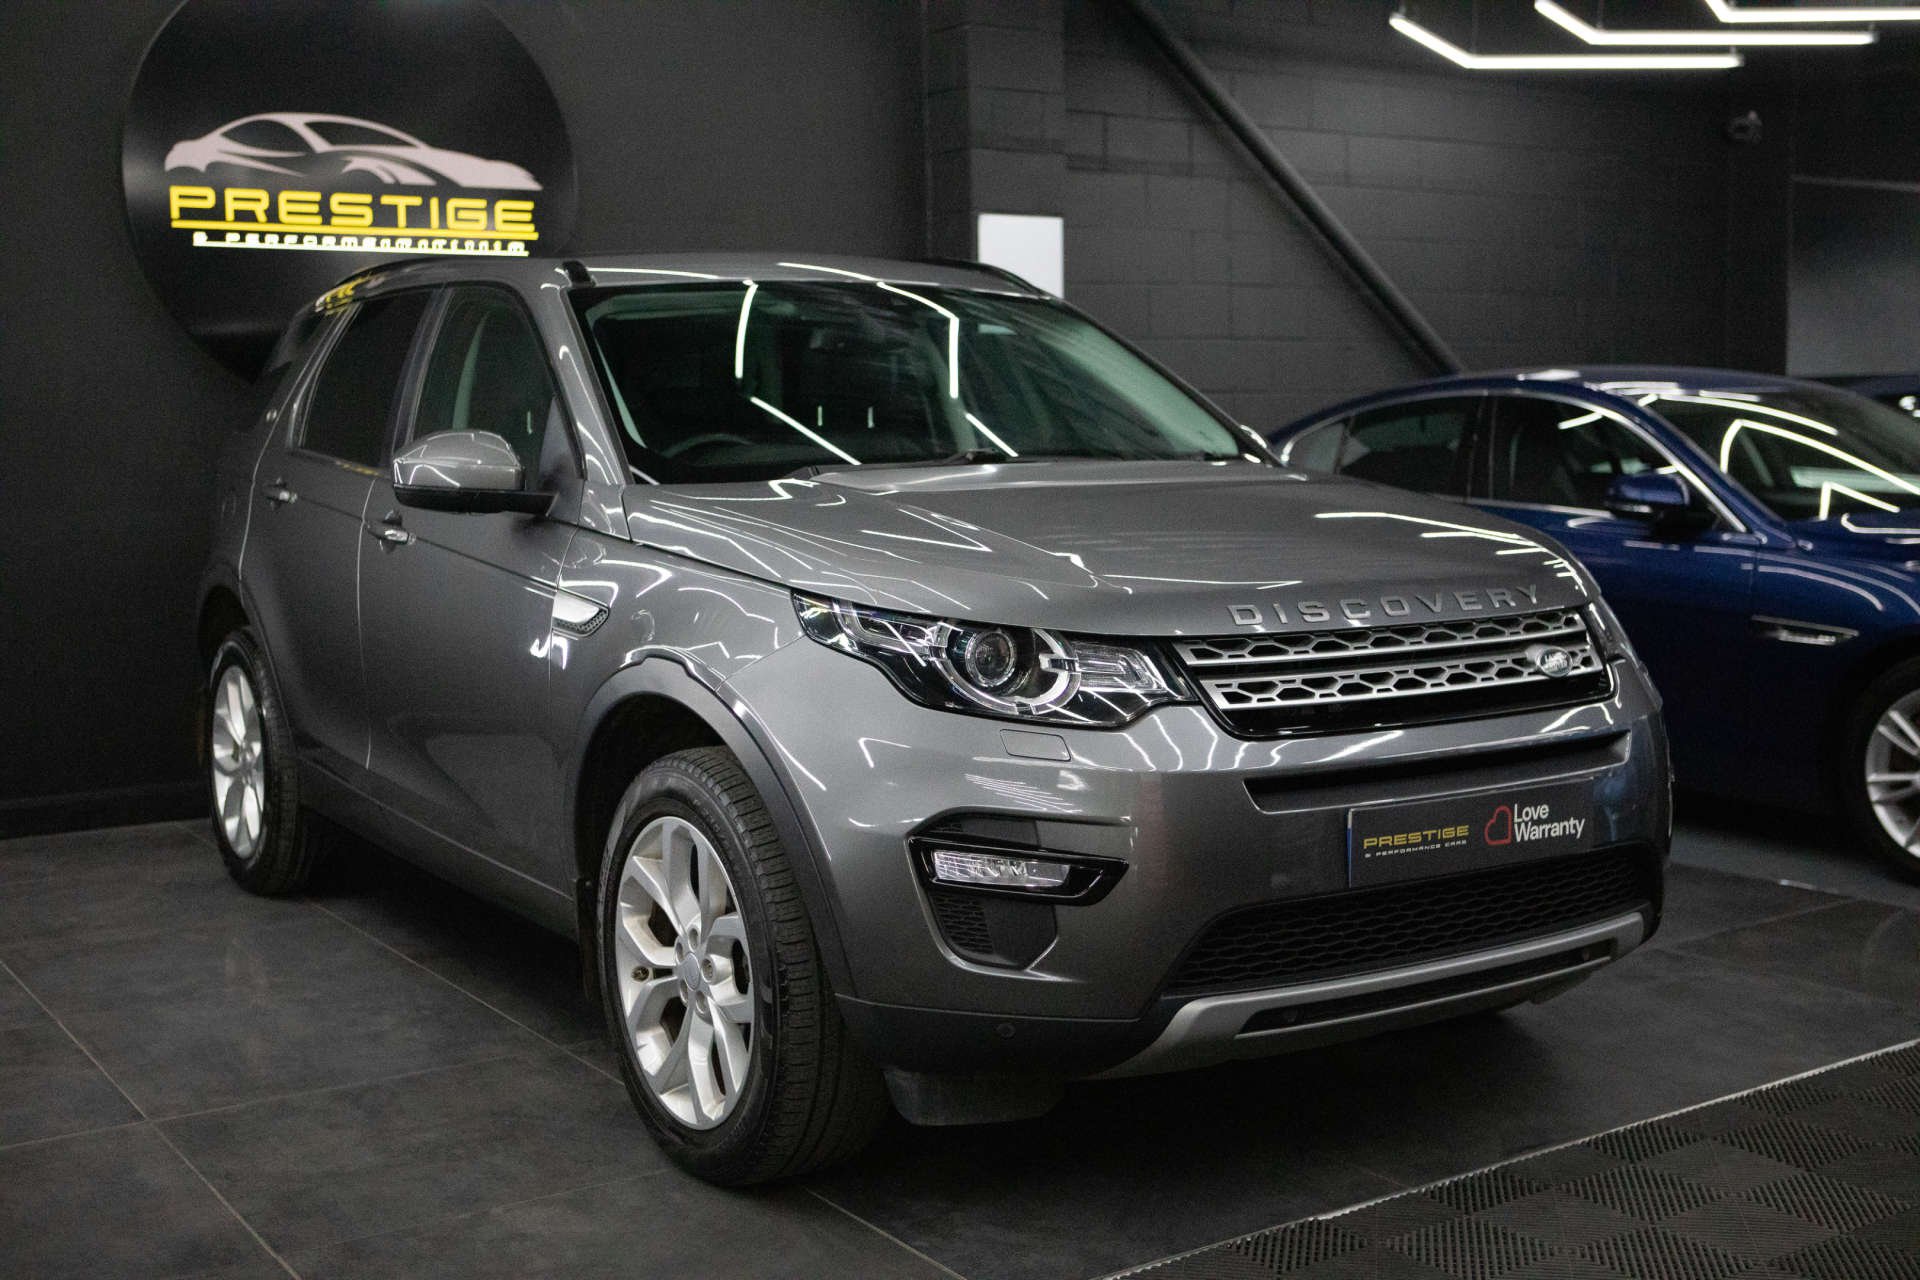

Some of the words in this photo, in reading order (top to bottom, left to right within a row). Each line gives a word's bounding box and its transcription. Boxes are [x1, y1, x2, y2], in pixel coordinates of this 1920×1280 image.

[169, 185, 535, 232] PRESTIGE
[1227, 584, 1538, 626] DISCOVERY
[1514, 803, 1549, 822] Love
[1363, 825, 1470, 849] PRESTIGE
[1514, 817, 1585, 842] Warranty
